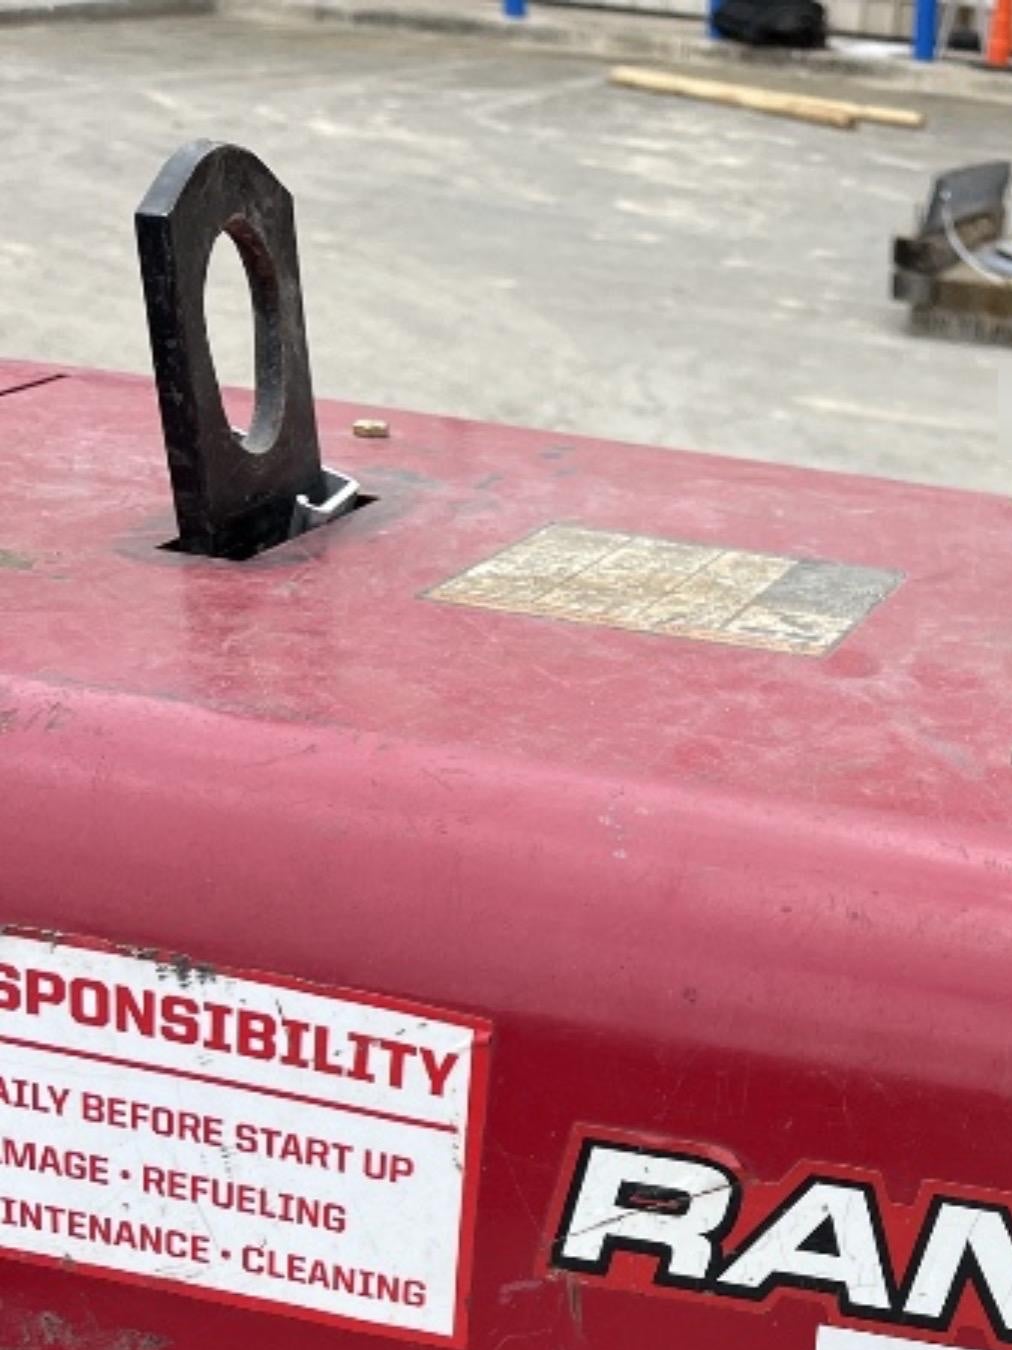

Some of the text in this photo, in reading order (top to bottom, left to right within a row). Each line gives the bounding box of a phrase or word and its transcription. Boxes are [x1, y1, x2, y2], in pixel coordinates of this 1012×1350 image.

[83, 1091, 223, 1147] BEFORE
[236, 1124, 354, 1173] START
[363, 1150, 414, 1184] UP
[0, 1138, 346, 1234] MAGE REFUELING
[241, 1246, 427, 1308] CLEANING
